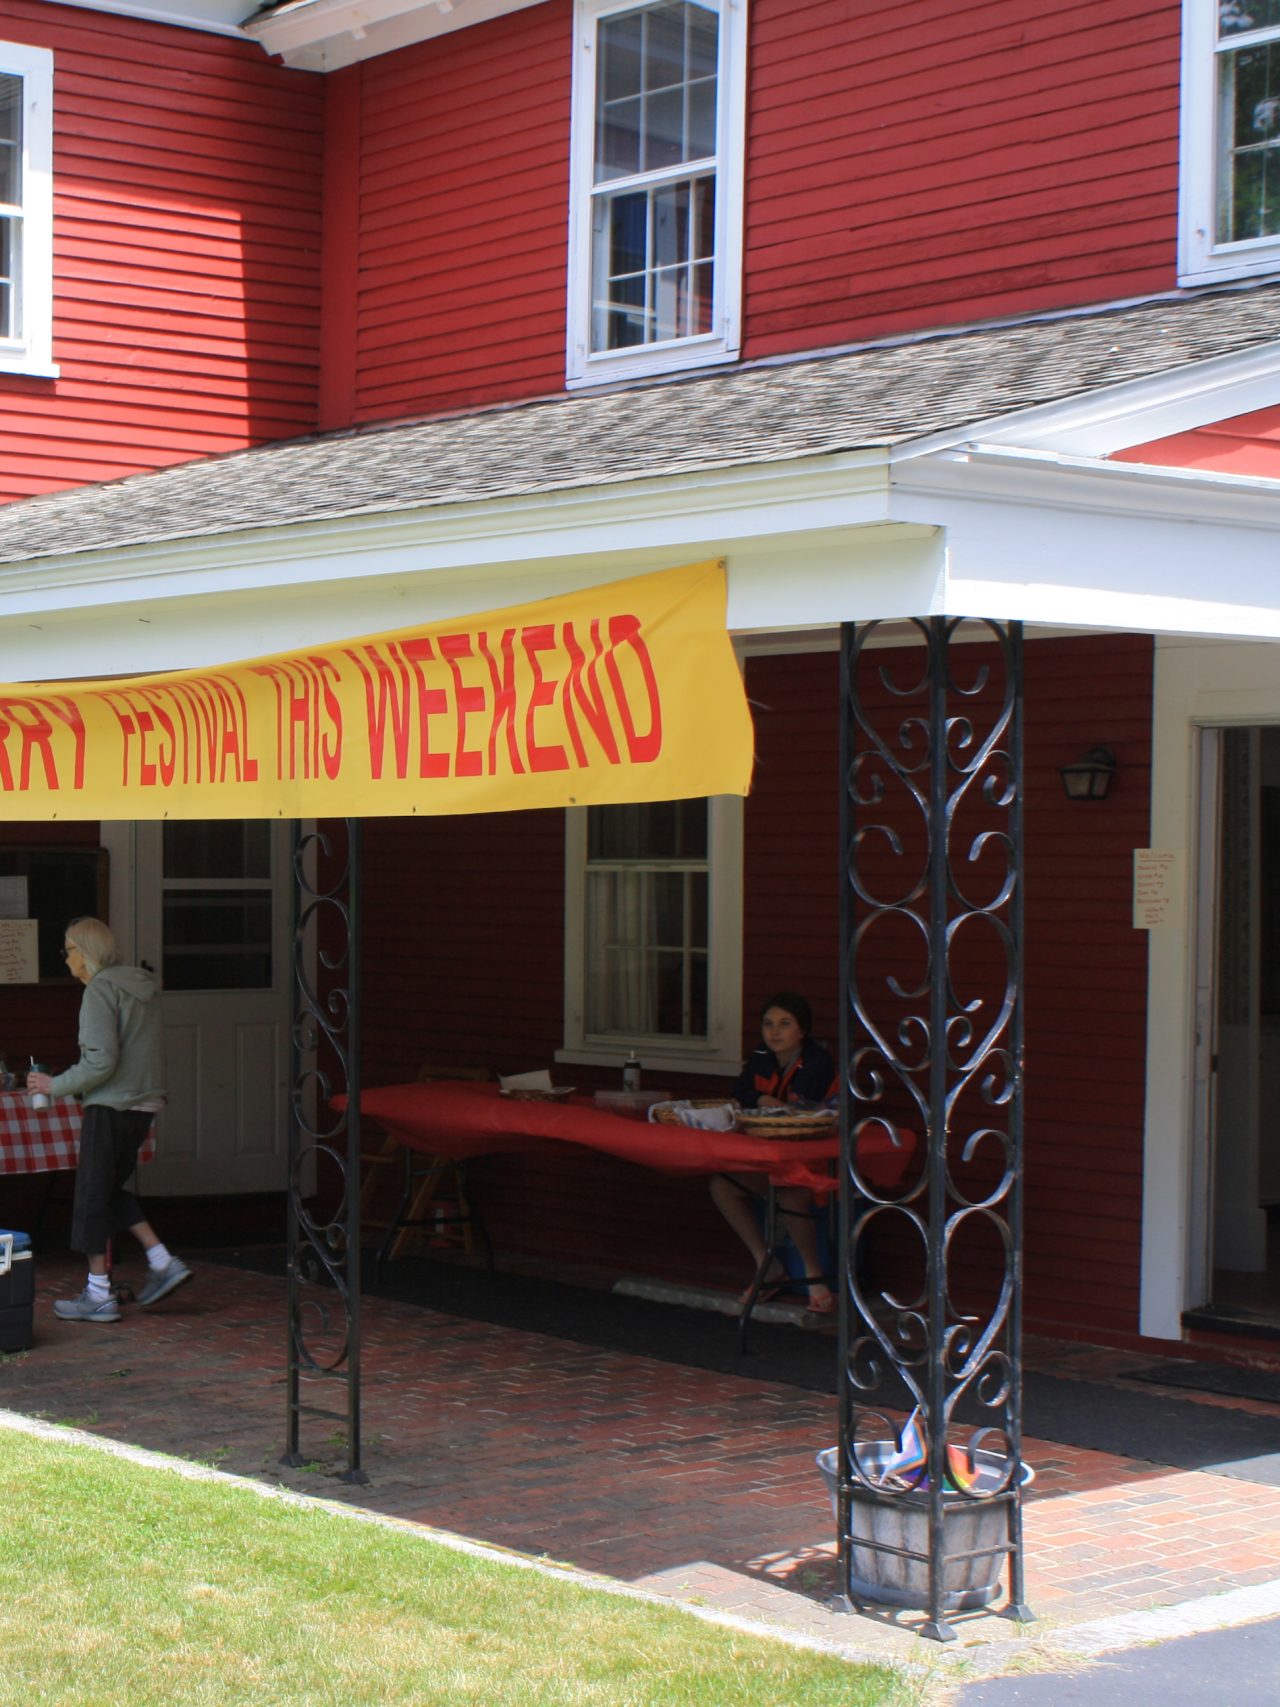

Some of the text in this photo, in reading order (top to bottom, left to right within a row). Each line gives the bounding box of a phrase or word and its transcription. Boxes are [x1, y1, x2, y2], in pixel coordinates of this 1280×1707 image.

[86, 674, 258, 786] FESTIVAL
[248, 656, 343, 780] THIS
[341, 614, 663, 780] WEEKEND
